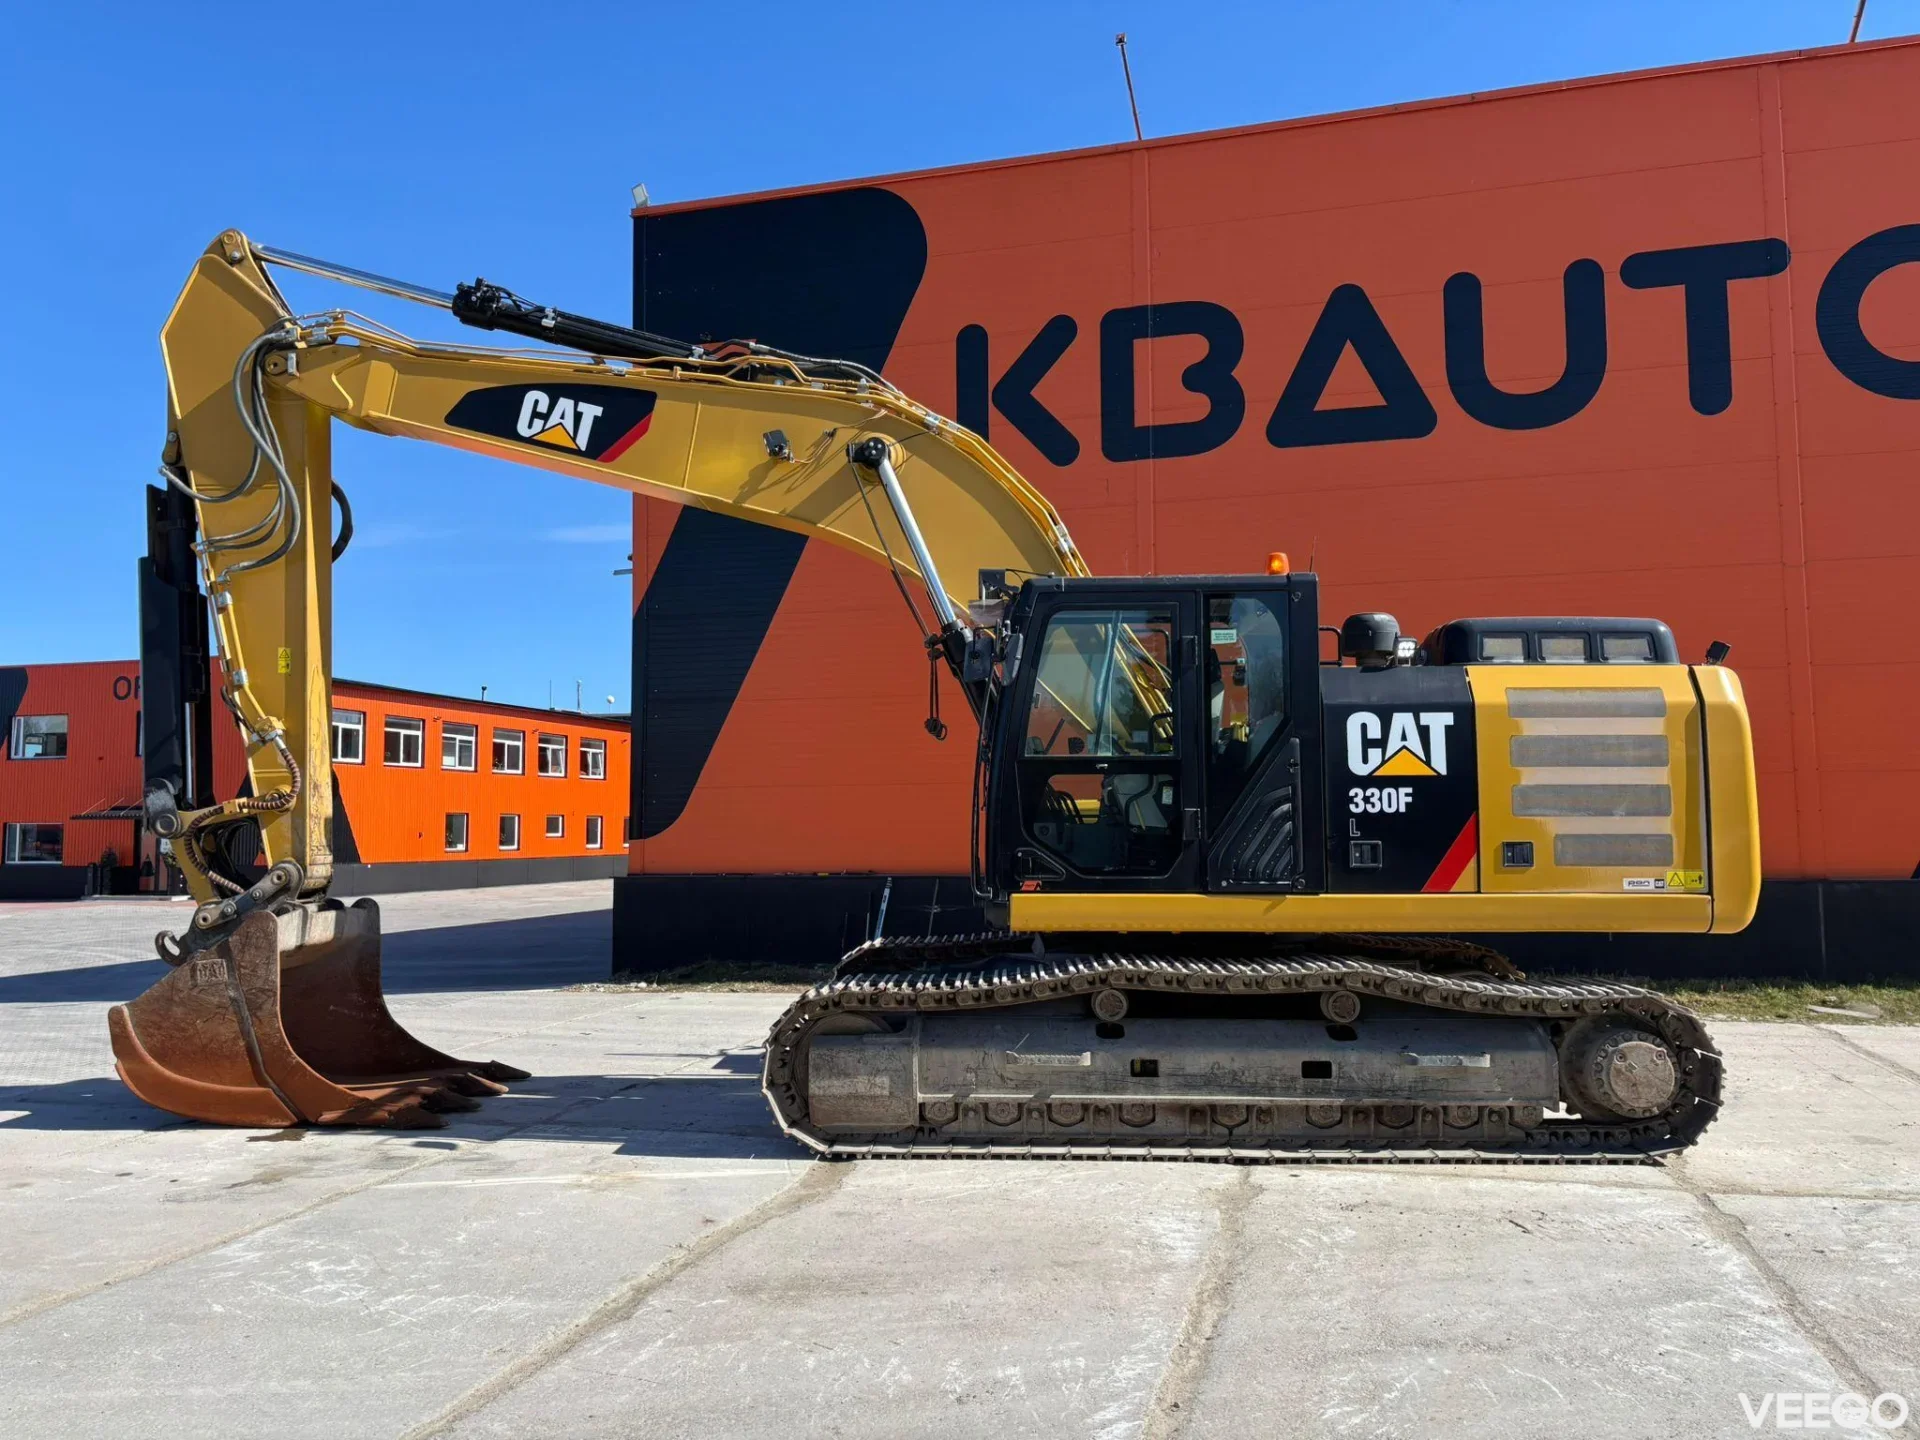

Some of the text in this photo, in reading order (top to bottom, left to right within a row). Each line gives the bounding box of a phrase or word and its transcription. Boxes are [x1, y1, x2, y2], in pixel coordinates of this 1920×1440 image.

[516, 390, 604, 452] CAT
[1346, 711, 1455, 776] CAT
[1349, 787, 1413, 813] 330F
[1349, 818, 1361, 837] L
